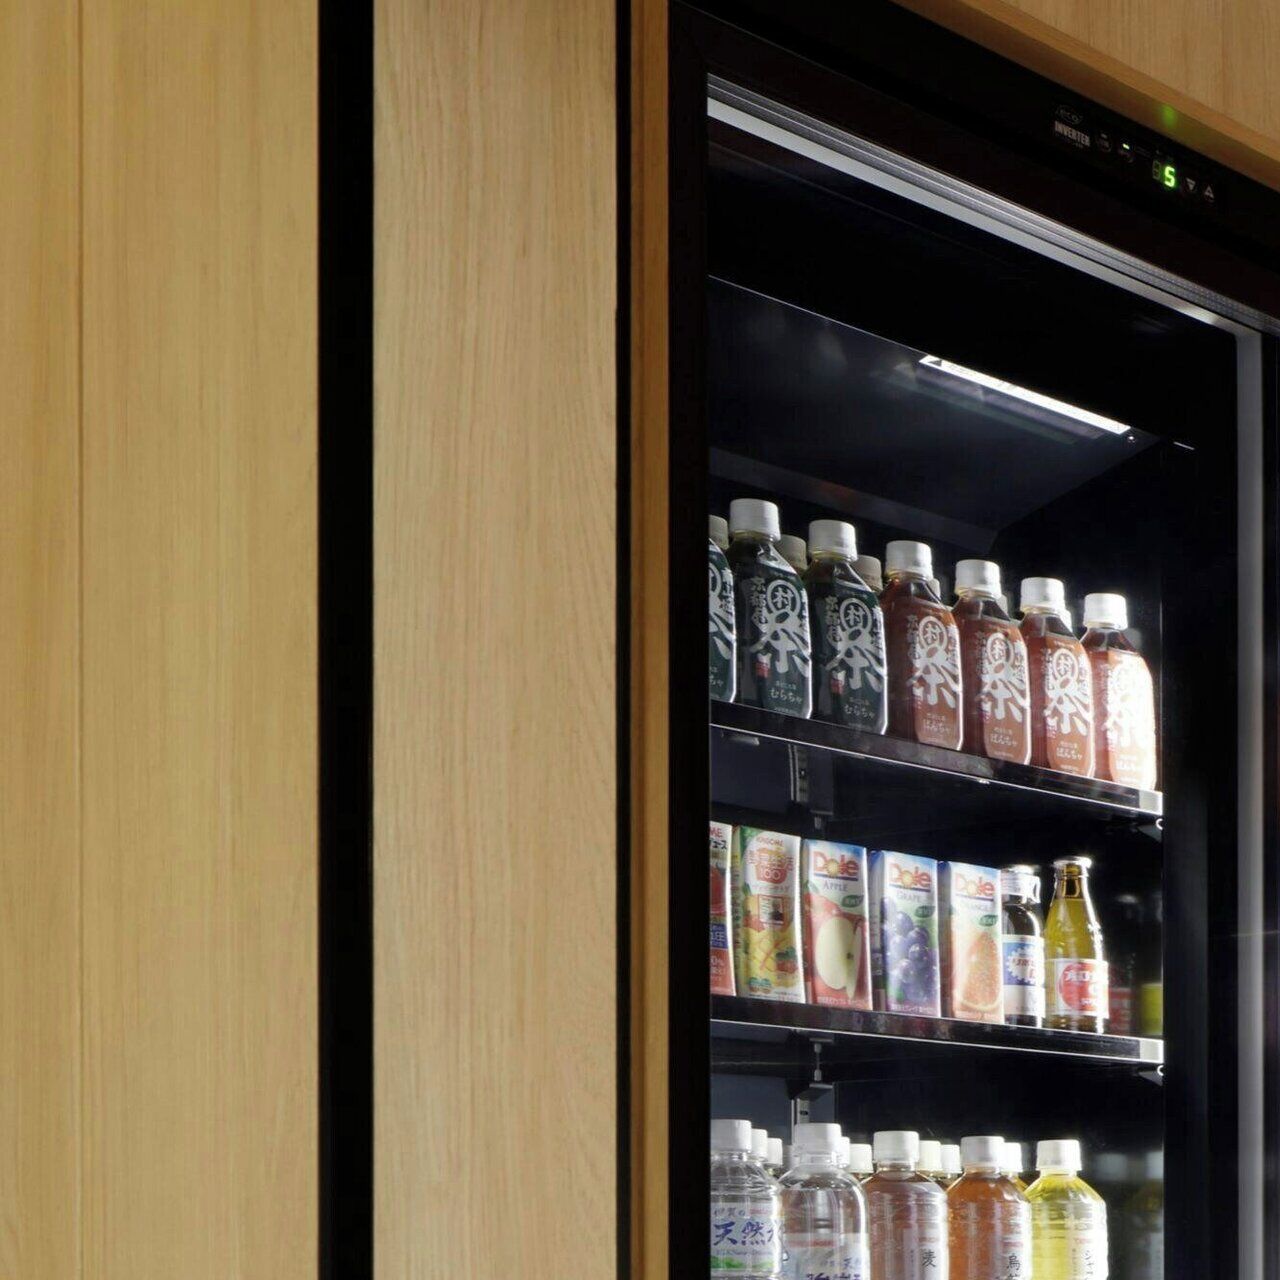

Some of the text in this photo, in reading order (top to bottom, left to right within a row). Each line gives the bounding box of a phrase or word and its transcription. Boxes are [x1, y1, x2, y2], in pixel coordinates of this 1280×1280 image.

[1164, 165, 1176, 188] 5
[813, 851, 860, 879] Dole
[890, 863, 932, 890] Dole
[823, 879, 849, 892] APPLE
[955, 872, 996, 897] Dole
